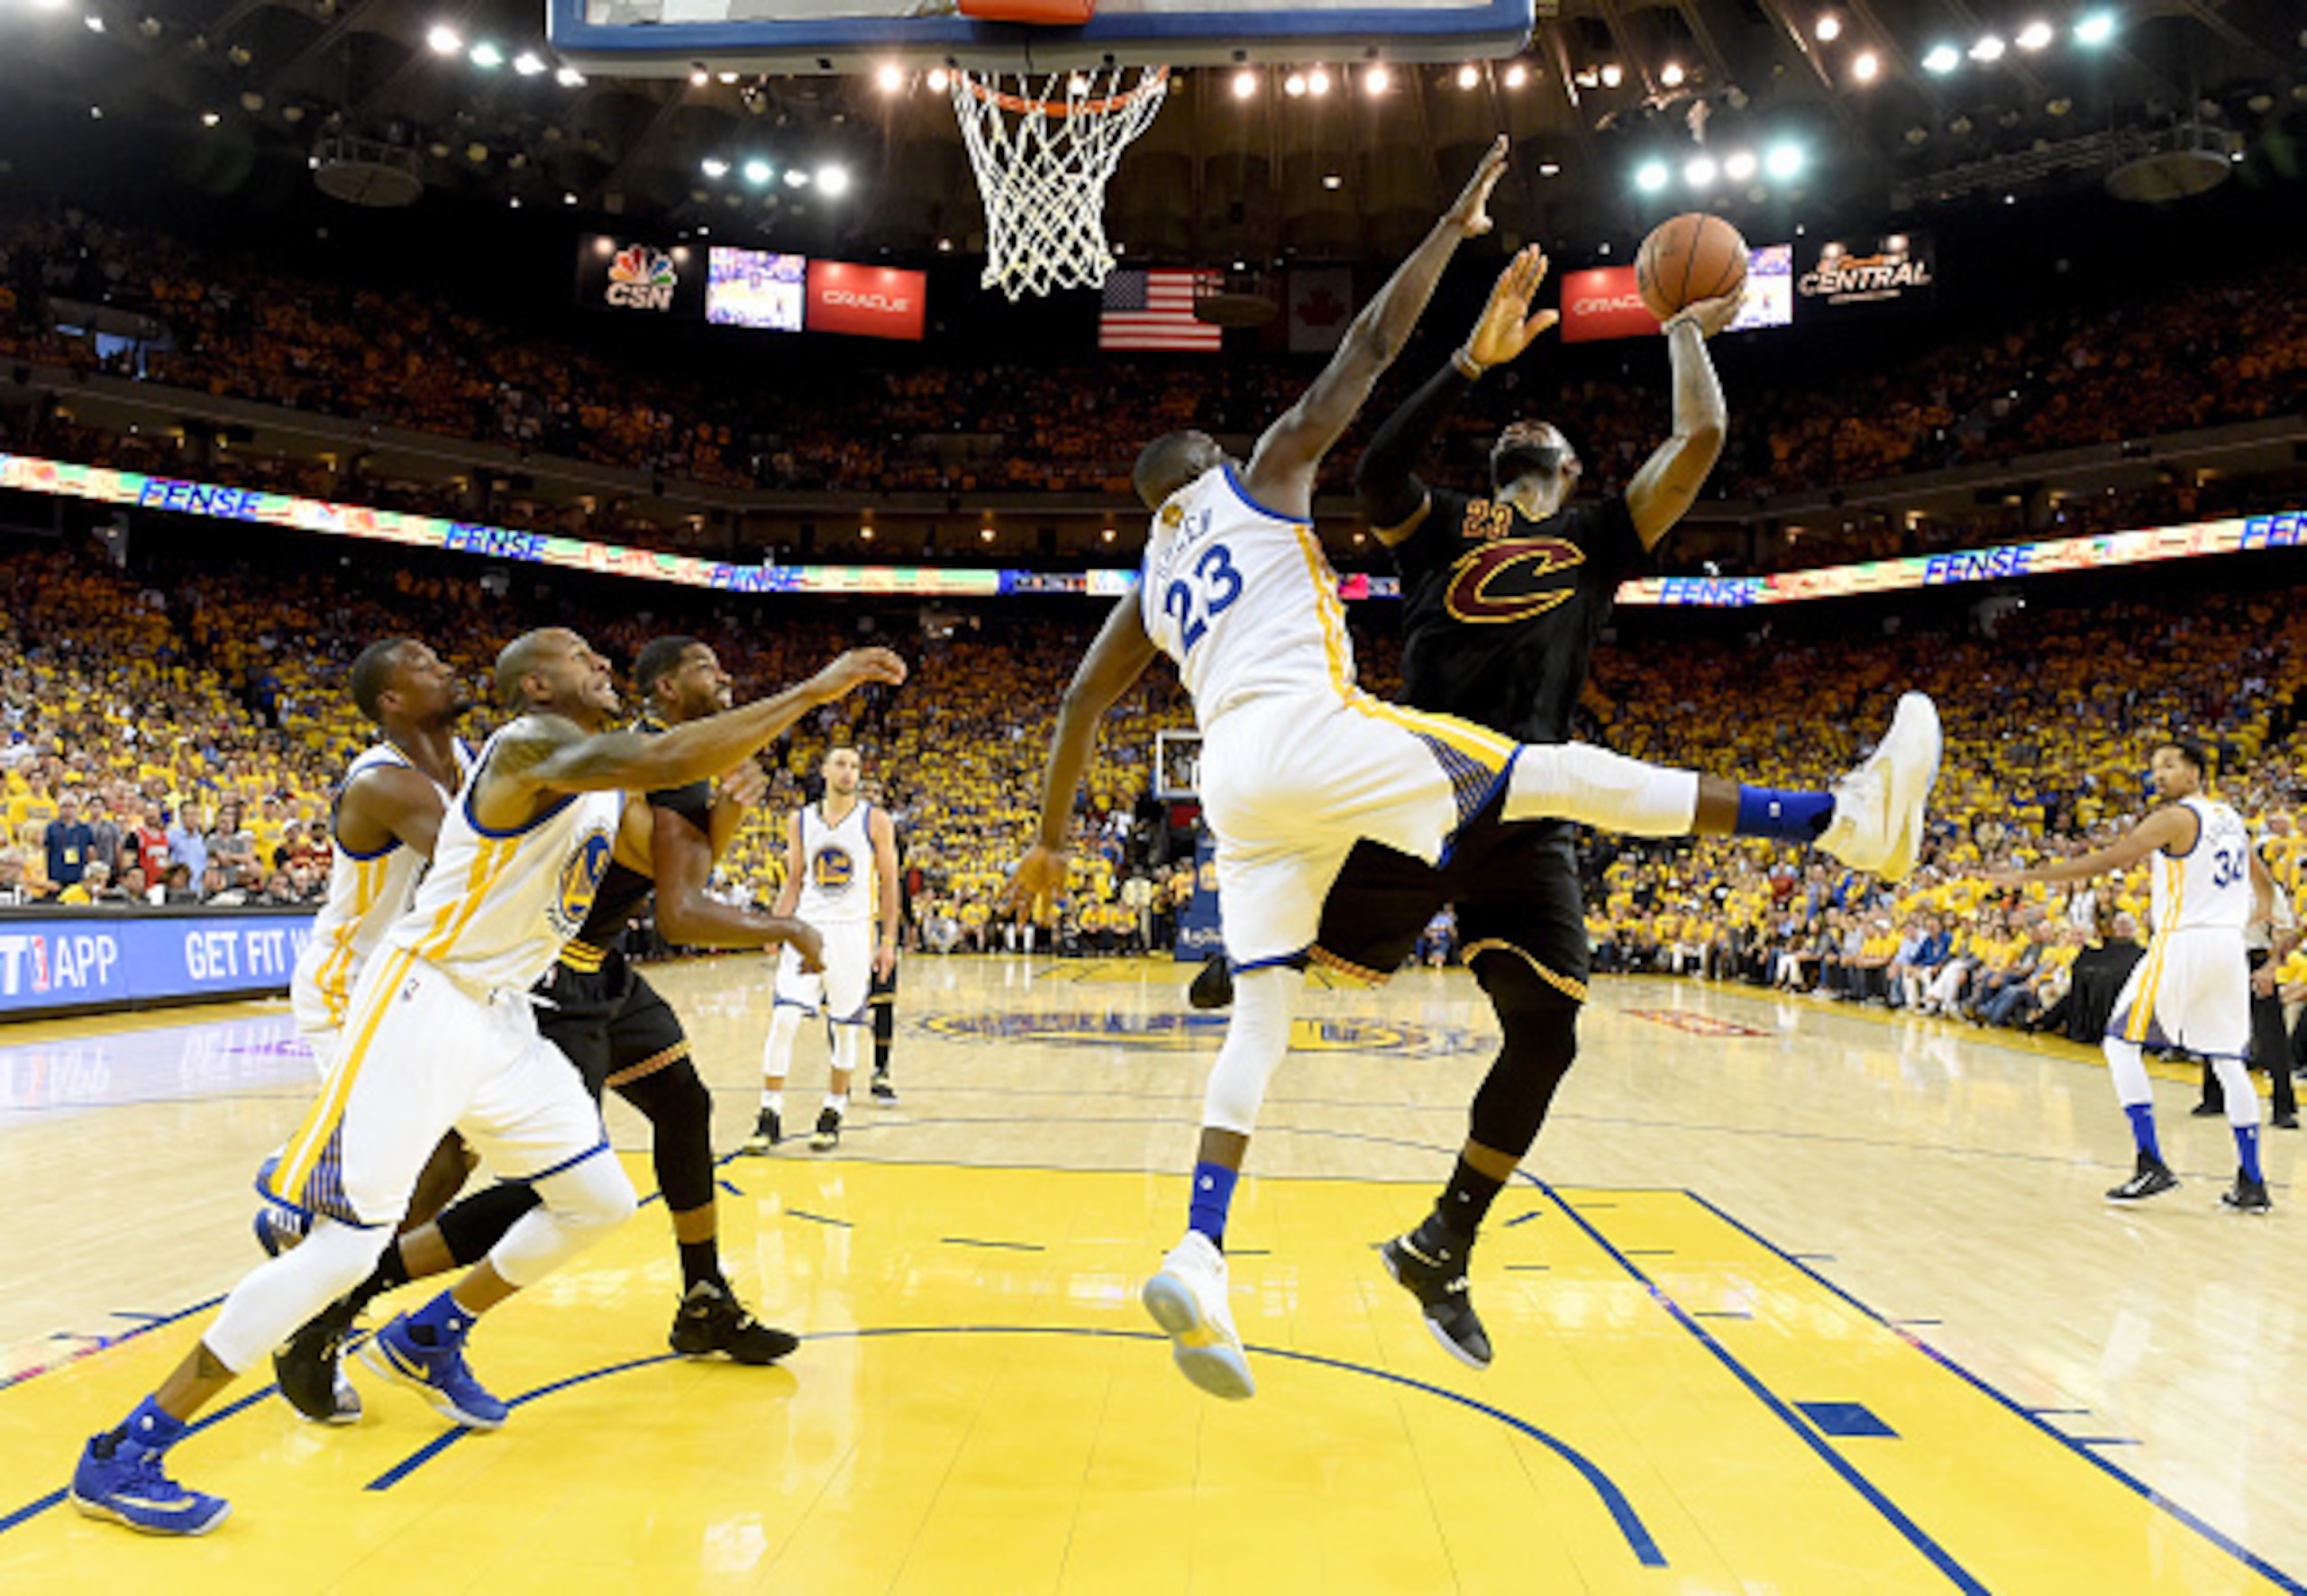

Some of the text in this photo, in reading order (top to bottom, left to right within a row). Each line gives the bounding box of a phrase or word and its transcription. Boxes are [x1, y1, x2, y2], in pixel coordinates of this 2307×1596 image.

[605, 282, 674, 311] CSN
[1798, 260, 1932, 297] CENTRAL
[822, 289, 911, 313] ORACLE
[1571, 293, 1645, 316] ORAC
[140, 476, 263, 522] FENSE
[1923, 545, 2035, 585] FENSE
[1163, 543, 1244, 657] 23
[54, 935, 118, 989] APP
[185, 930, 239, 980] GET
[244, 928, 285, 976] FIT
